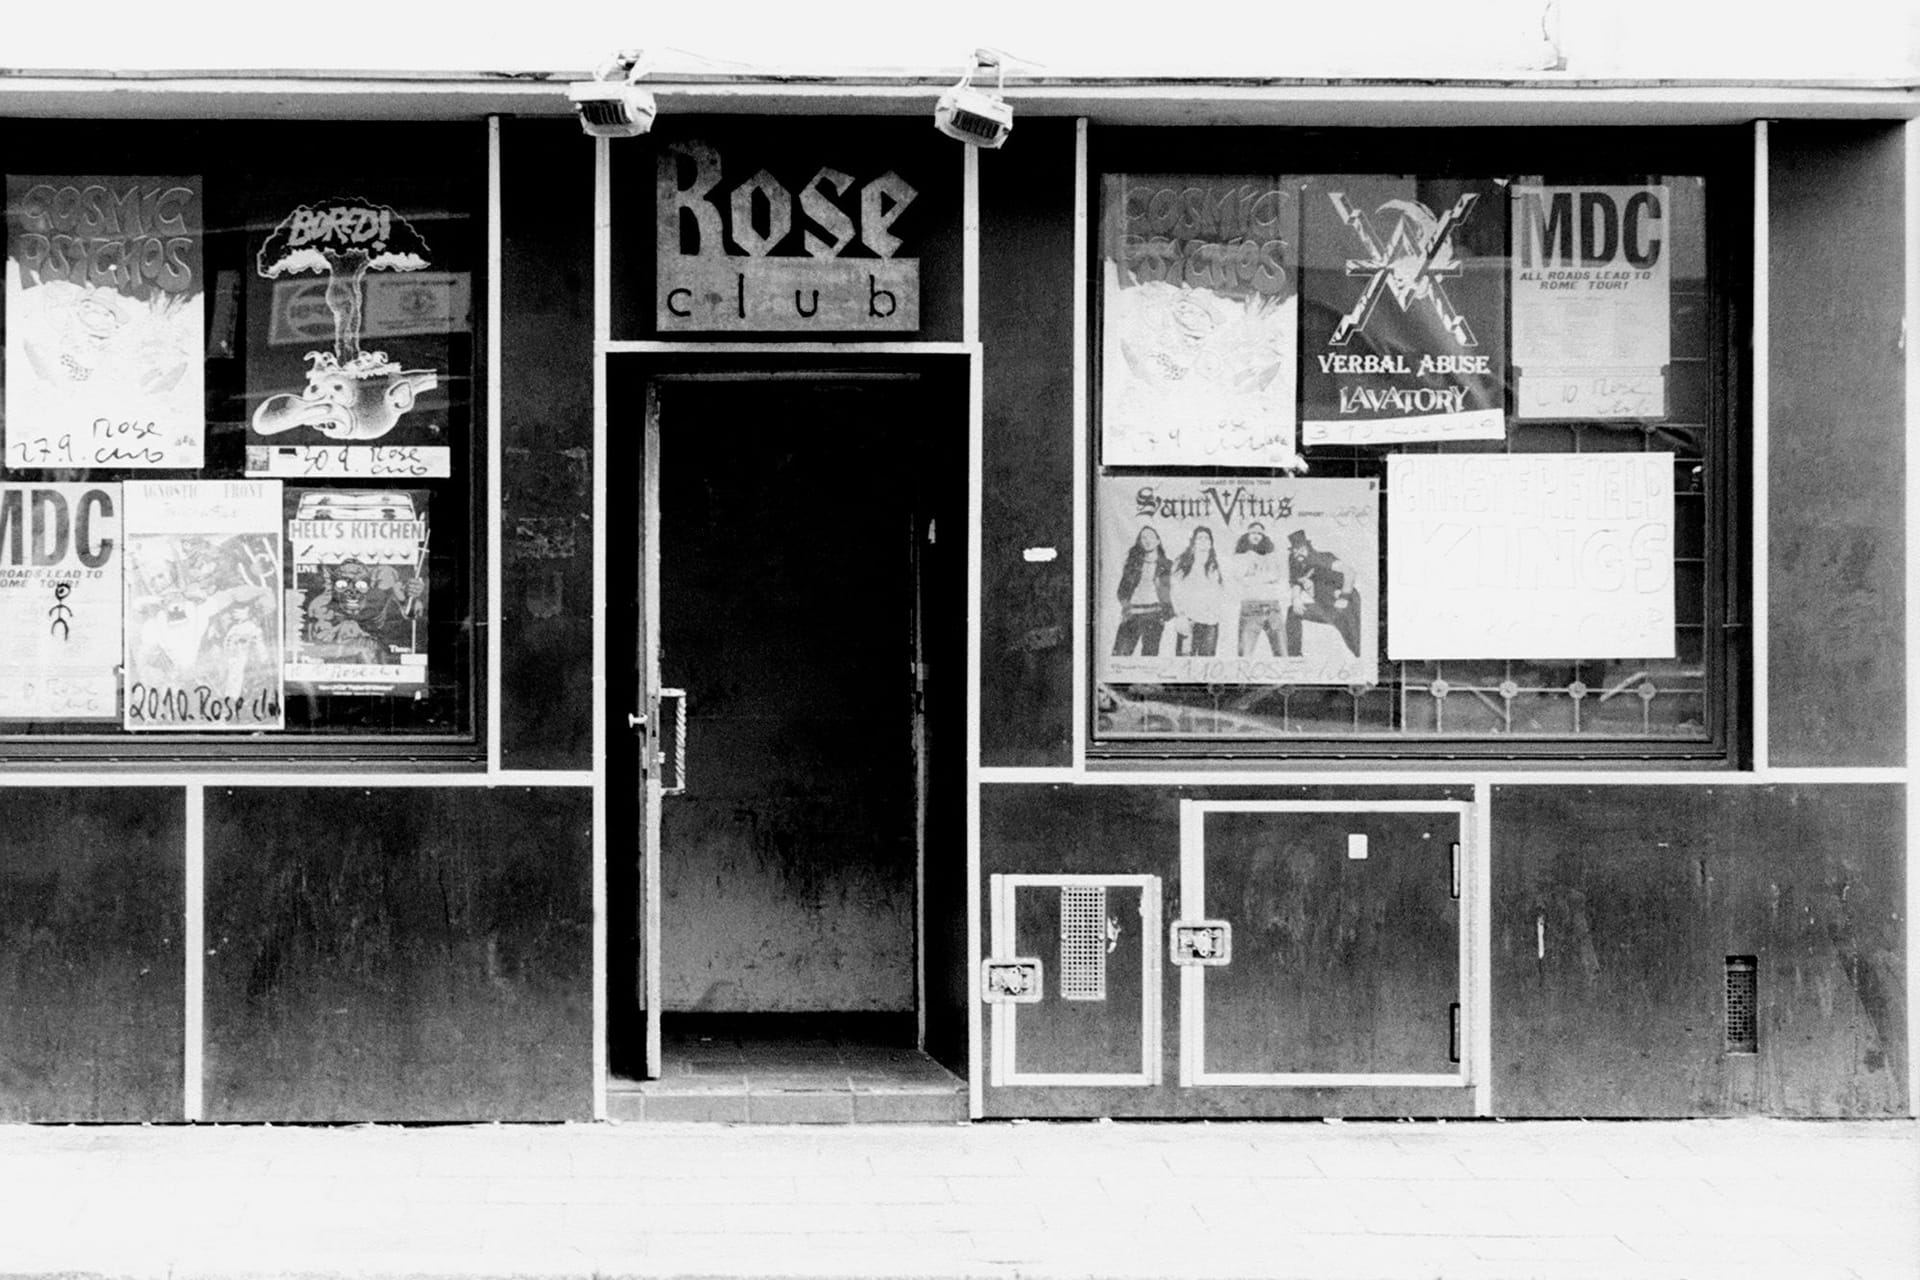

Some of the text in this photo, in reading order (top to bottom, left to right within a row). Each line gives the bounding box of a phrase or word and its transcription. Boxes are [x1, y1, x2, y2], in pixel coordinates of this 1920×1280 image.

[656, 140, 919, 258] Rose
[288, 205, 391, 252] BORED!
[1520, 191, 1662, 269] MDC
[1519, 271, 1652, 281] ALL ROADS LEAD TO
[1539, 281, 1628, 290] ROME TOUR!
[667, 272, 896, 318] club
[1317, 353, 1492, 377] VERBAL ABUSE
[1339, 385, 1470, 414] LAVATORY
[291, 521, 423, 540] HELL'S KITCHEN
[0, 579, 28, 589] OME
[47, 570, 82, 580] LEAD
[85, 570, 103, 580] TO
